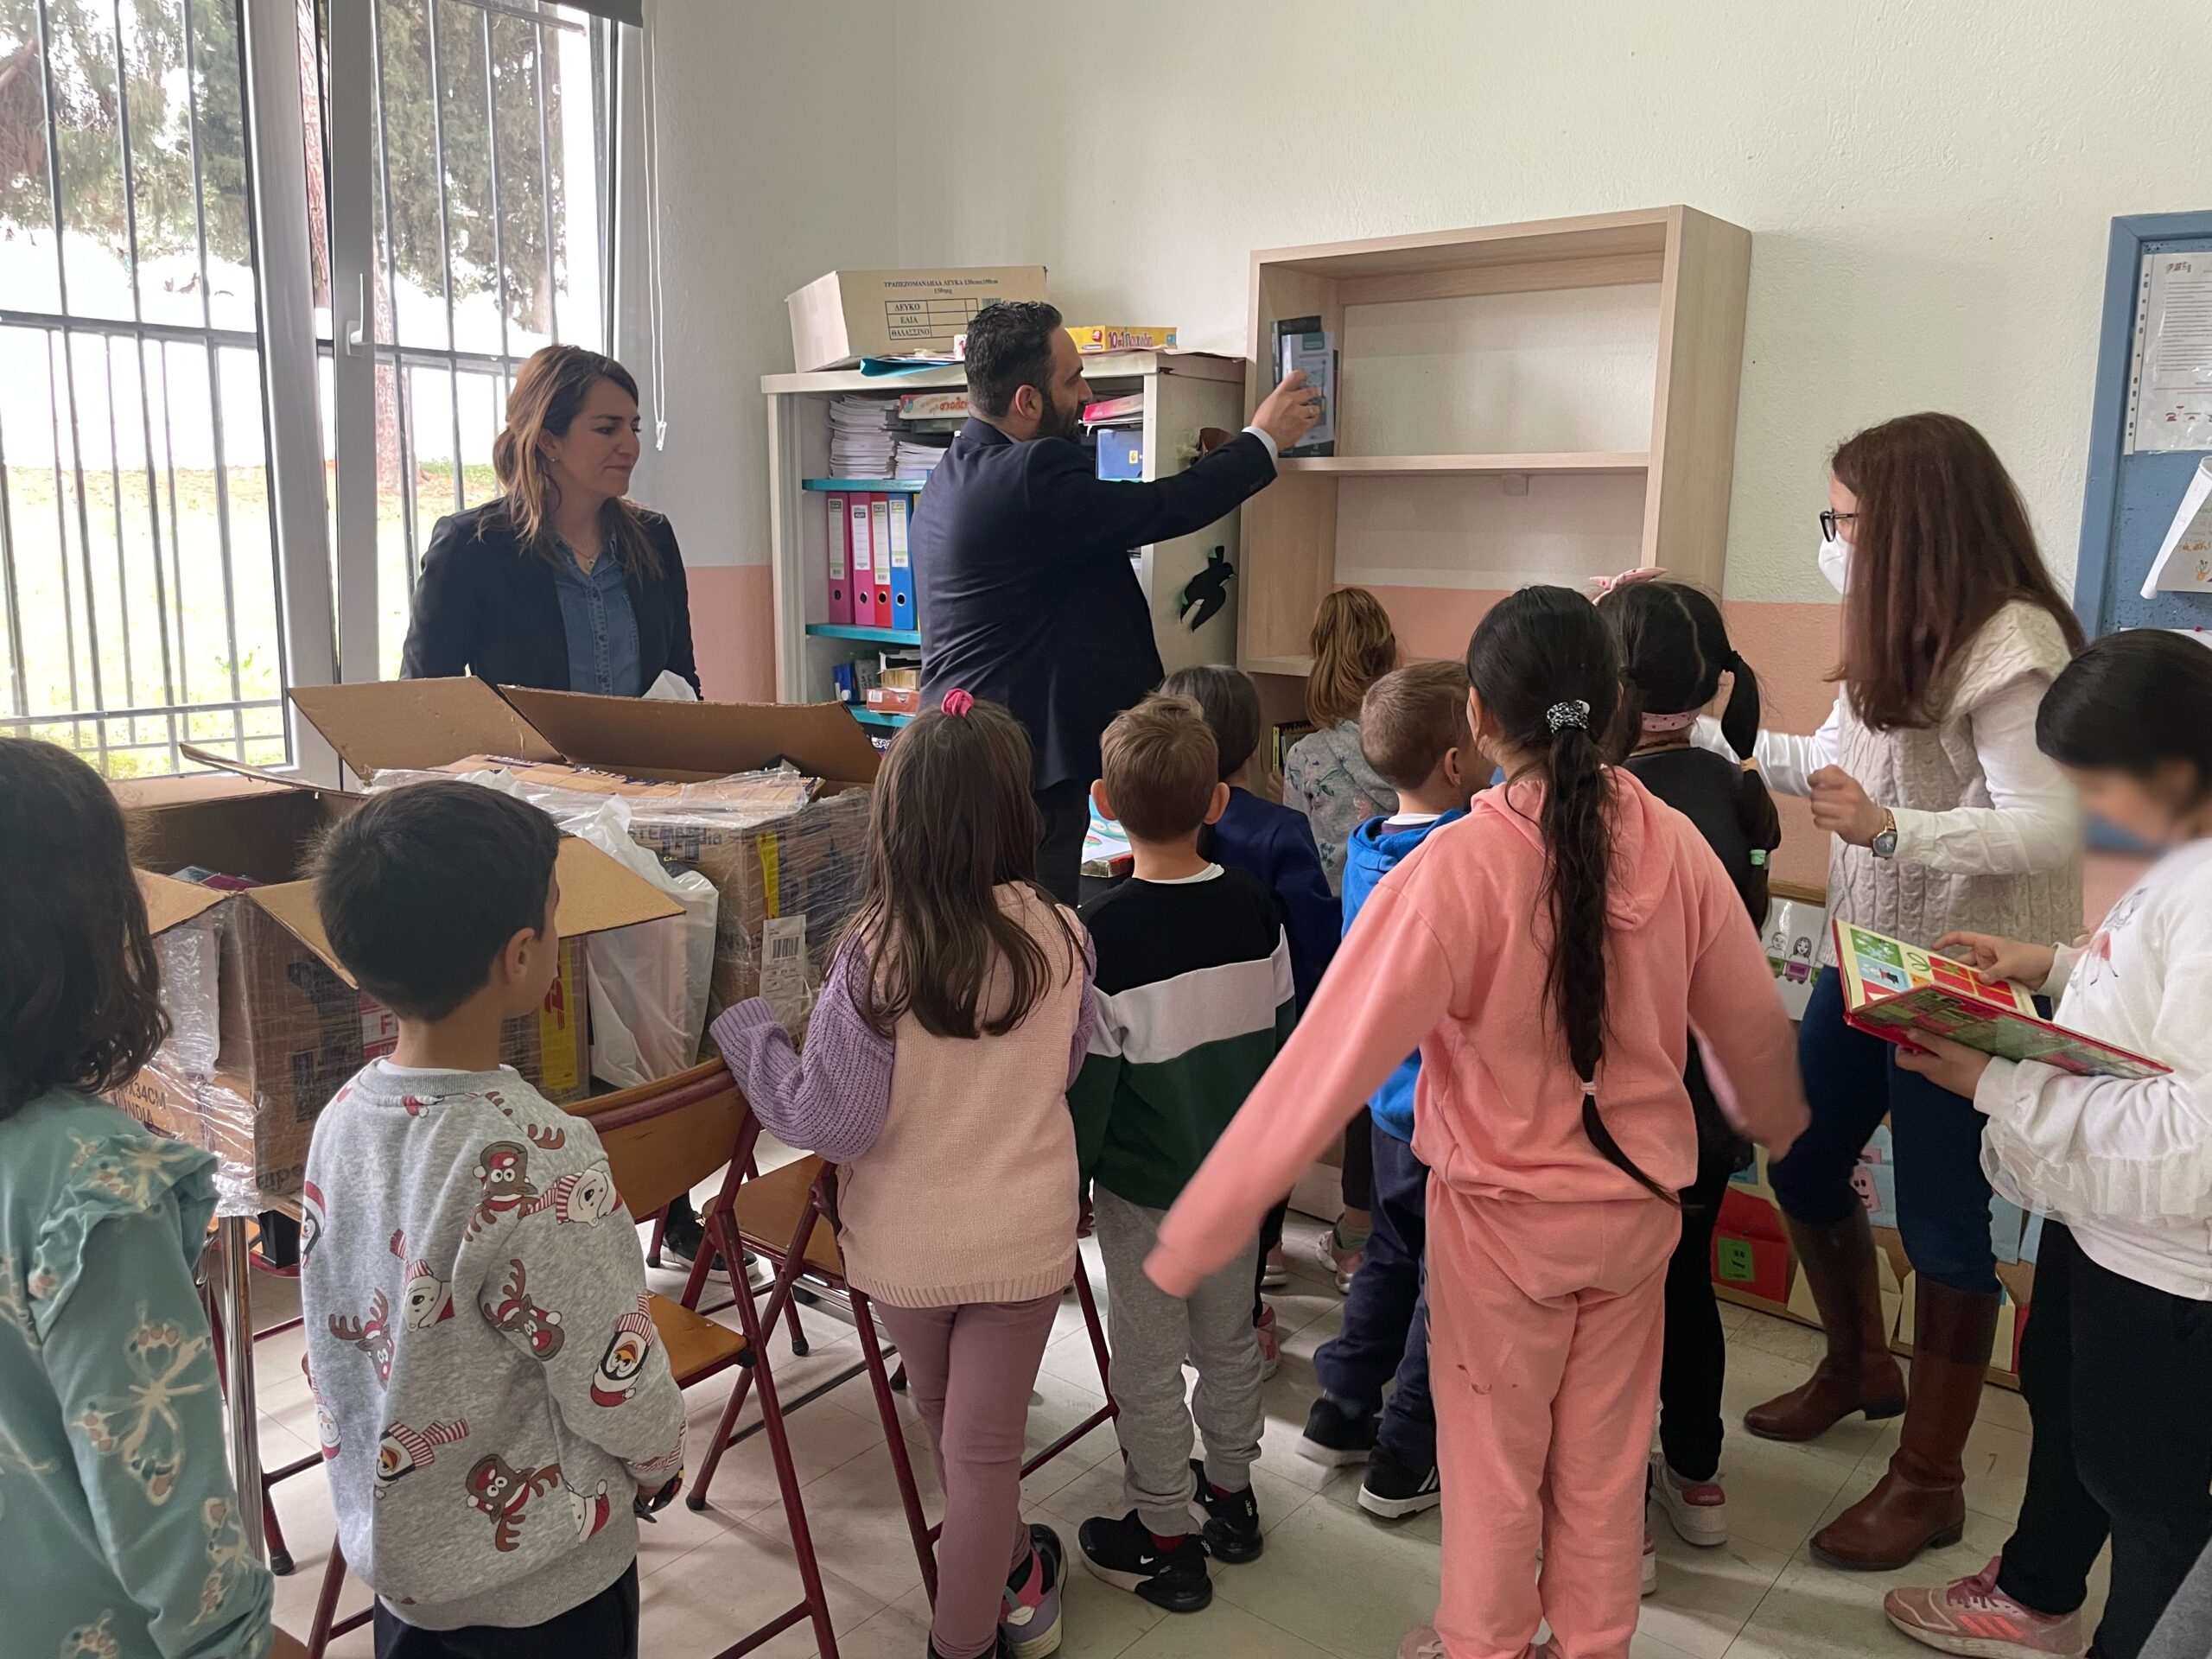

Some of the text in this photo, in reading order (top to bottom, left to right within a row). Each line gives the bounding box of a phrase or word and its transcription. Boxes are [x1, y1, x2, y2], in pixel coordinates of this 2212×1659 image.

[894, 303, 920, 312] ΛΕΥΚΟ
[891, 327, 930, 338] ΘΑΛΑΣΣΙΝΟ
[124, 1097, 155, 1126] INDIA
